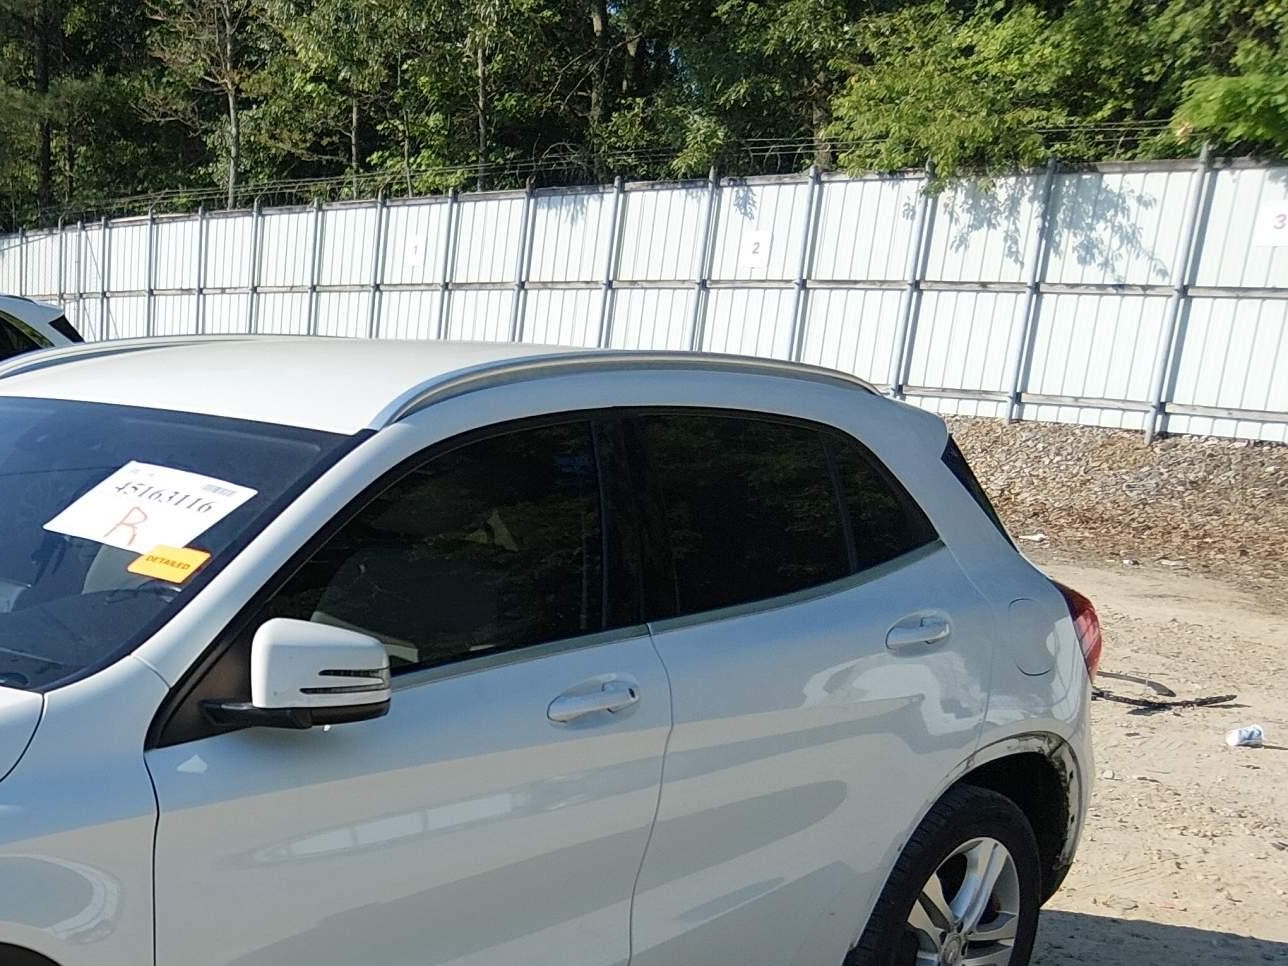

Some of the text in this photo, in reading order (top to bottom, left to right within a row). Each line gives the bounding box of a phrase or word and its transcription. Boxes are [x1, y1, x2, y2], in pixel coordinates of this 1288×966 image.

[1272, 213, 1288, 230] 3
[751, 241, 761, 255] 2
[103, 506, 148, 547] R
[146, 555, 192, 571] DETAILED
